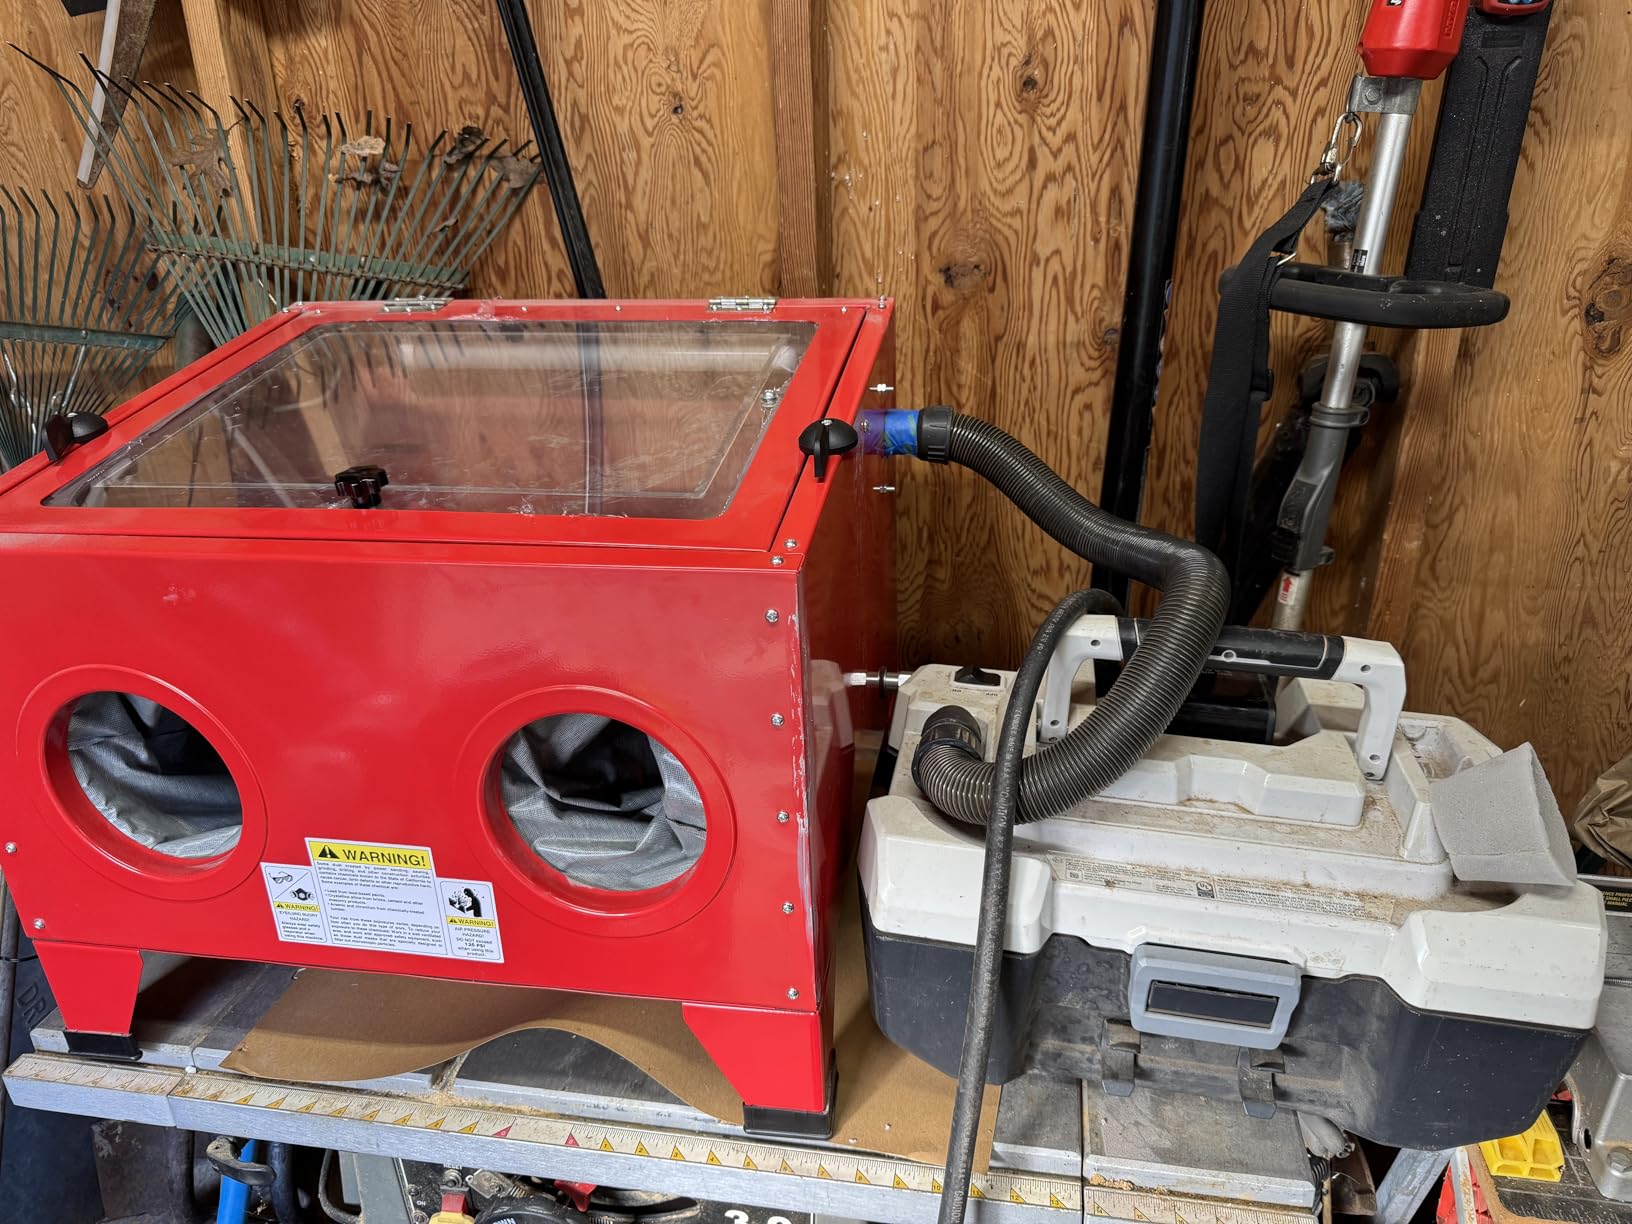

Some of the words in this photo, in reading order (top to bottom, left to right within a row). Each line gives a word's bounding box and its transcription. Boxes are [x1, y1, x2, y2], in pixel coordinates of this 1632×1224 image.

[343, 848, 426, 866] WARNING!
[285, 903, 318, 911] WARNING!
[458, 918, 494, 927] WARNING!
